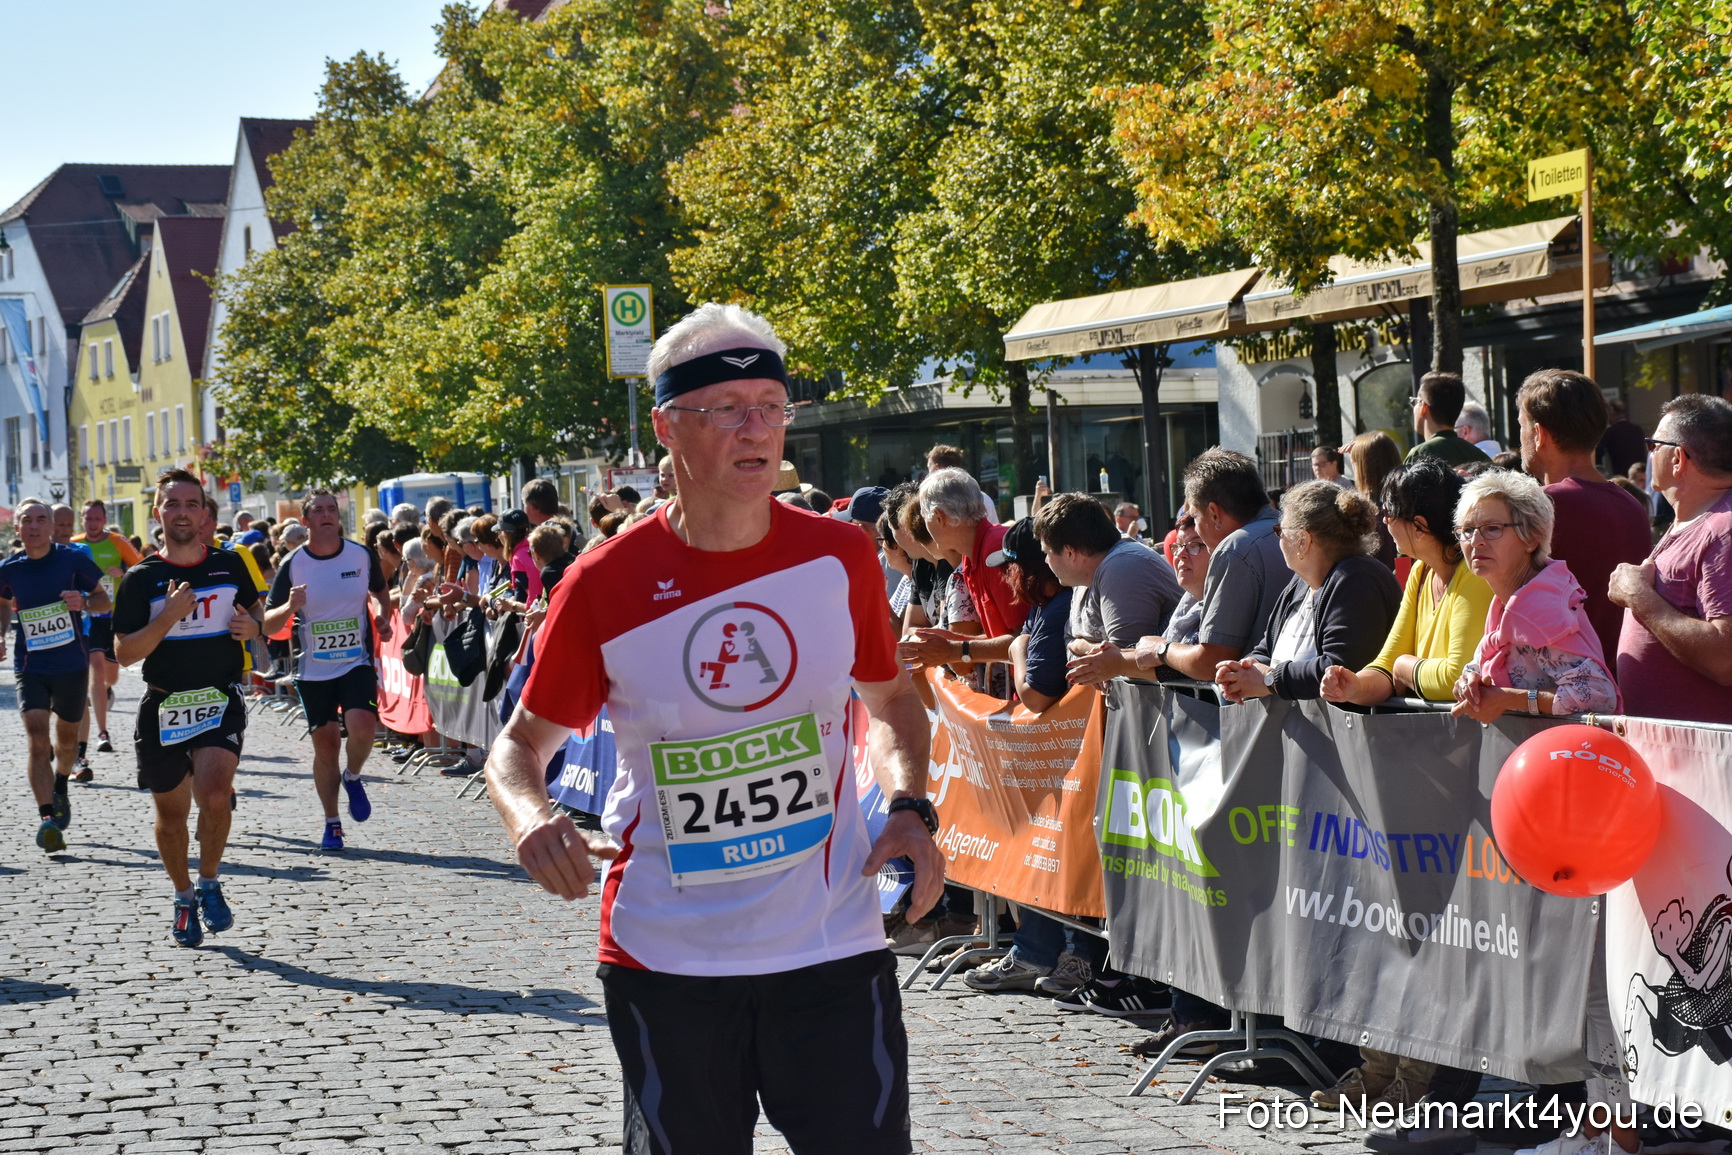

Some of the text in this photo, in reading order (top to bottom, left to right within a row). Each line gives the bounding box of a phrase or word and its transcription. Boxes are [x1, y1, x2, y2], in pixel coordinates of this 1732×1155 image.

[1538, 165, 1584, 189] Toiletten
[620, 299, 637, 319] H
[653, 588, 682, 600] erima
[23, 604, 60, 621] BOCK
[28, 617, 67, 636] 2440
[315, 620, 354, 632] BOCK
[30, 631, 71, 646] WOLFGANG
[318, 633, 356, 650] 2222
[329, 651, 347, 659] UWE
[166, 690, 219, 706] BOCK
[168, 706, 220, 726] 2168
[170, 720, 213, 739] ANDREAS
[1016, 720, 1051, 734] moderner
[1051, 717, 1086, 731] Partner
[663, 723, 803, 779] BOCK
[1002, 740, 1039, 756] Konzeption
[1040, 739, 1057, 752] und
[1013, 757, 1046, 774] Projekte
[1046, 759, 1063, 770] was
[1550, 741, 1637, 784] RÖDL
[813, 768, 821, 776] D
[1597, 764, 1636, 789] energie
[1040, 777, 1052, 789] und
[678, 770, 813, 834] 2452
[722, 834, 786, 864] RUDI
[942, 823, 1000, 862] Agentur
[1100, 848, 1159, 880] inspired
[1161, 860, 1169, 888] by
